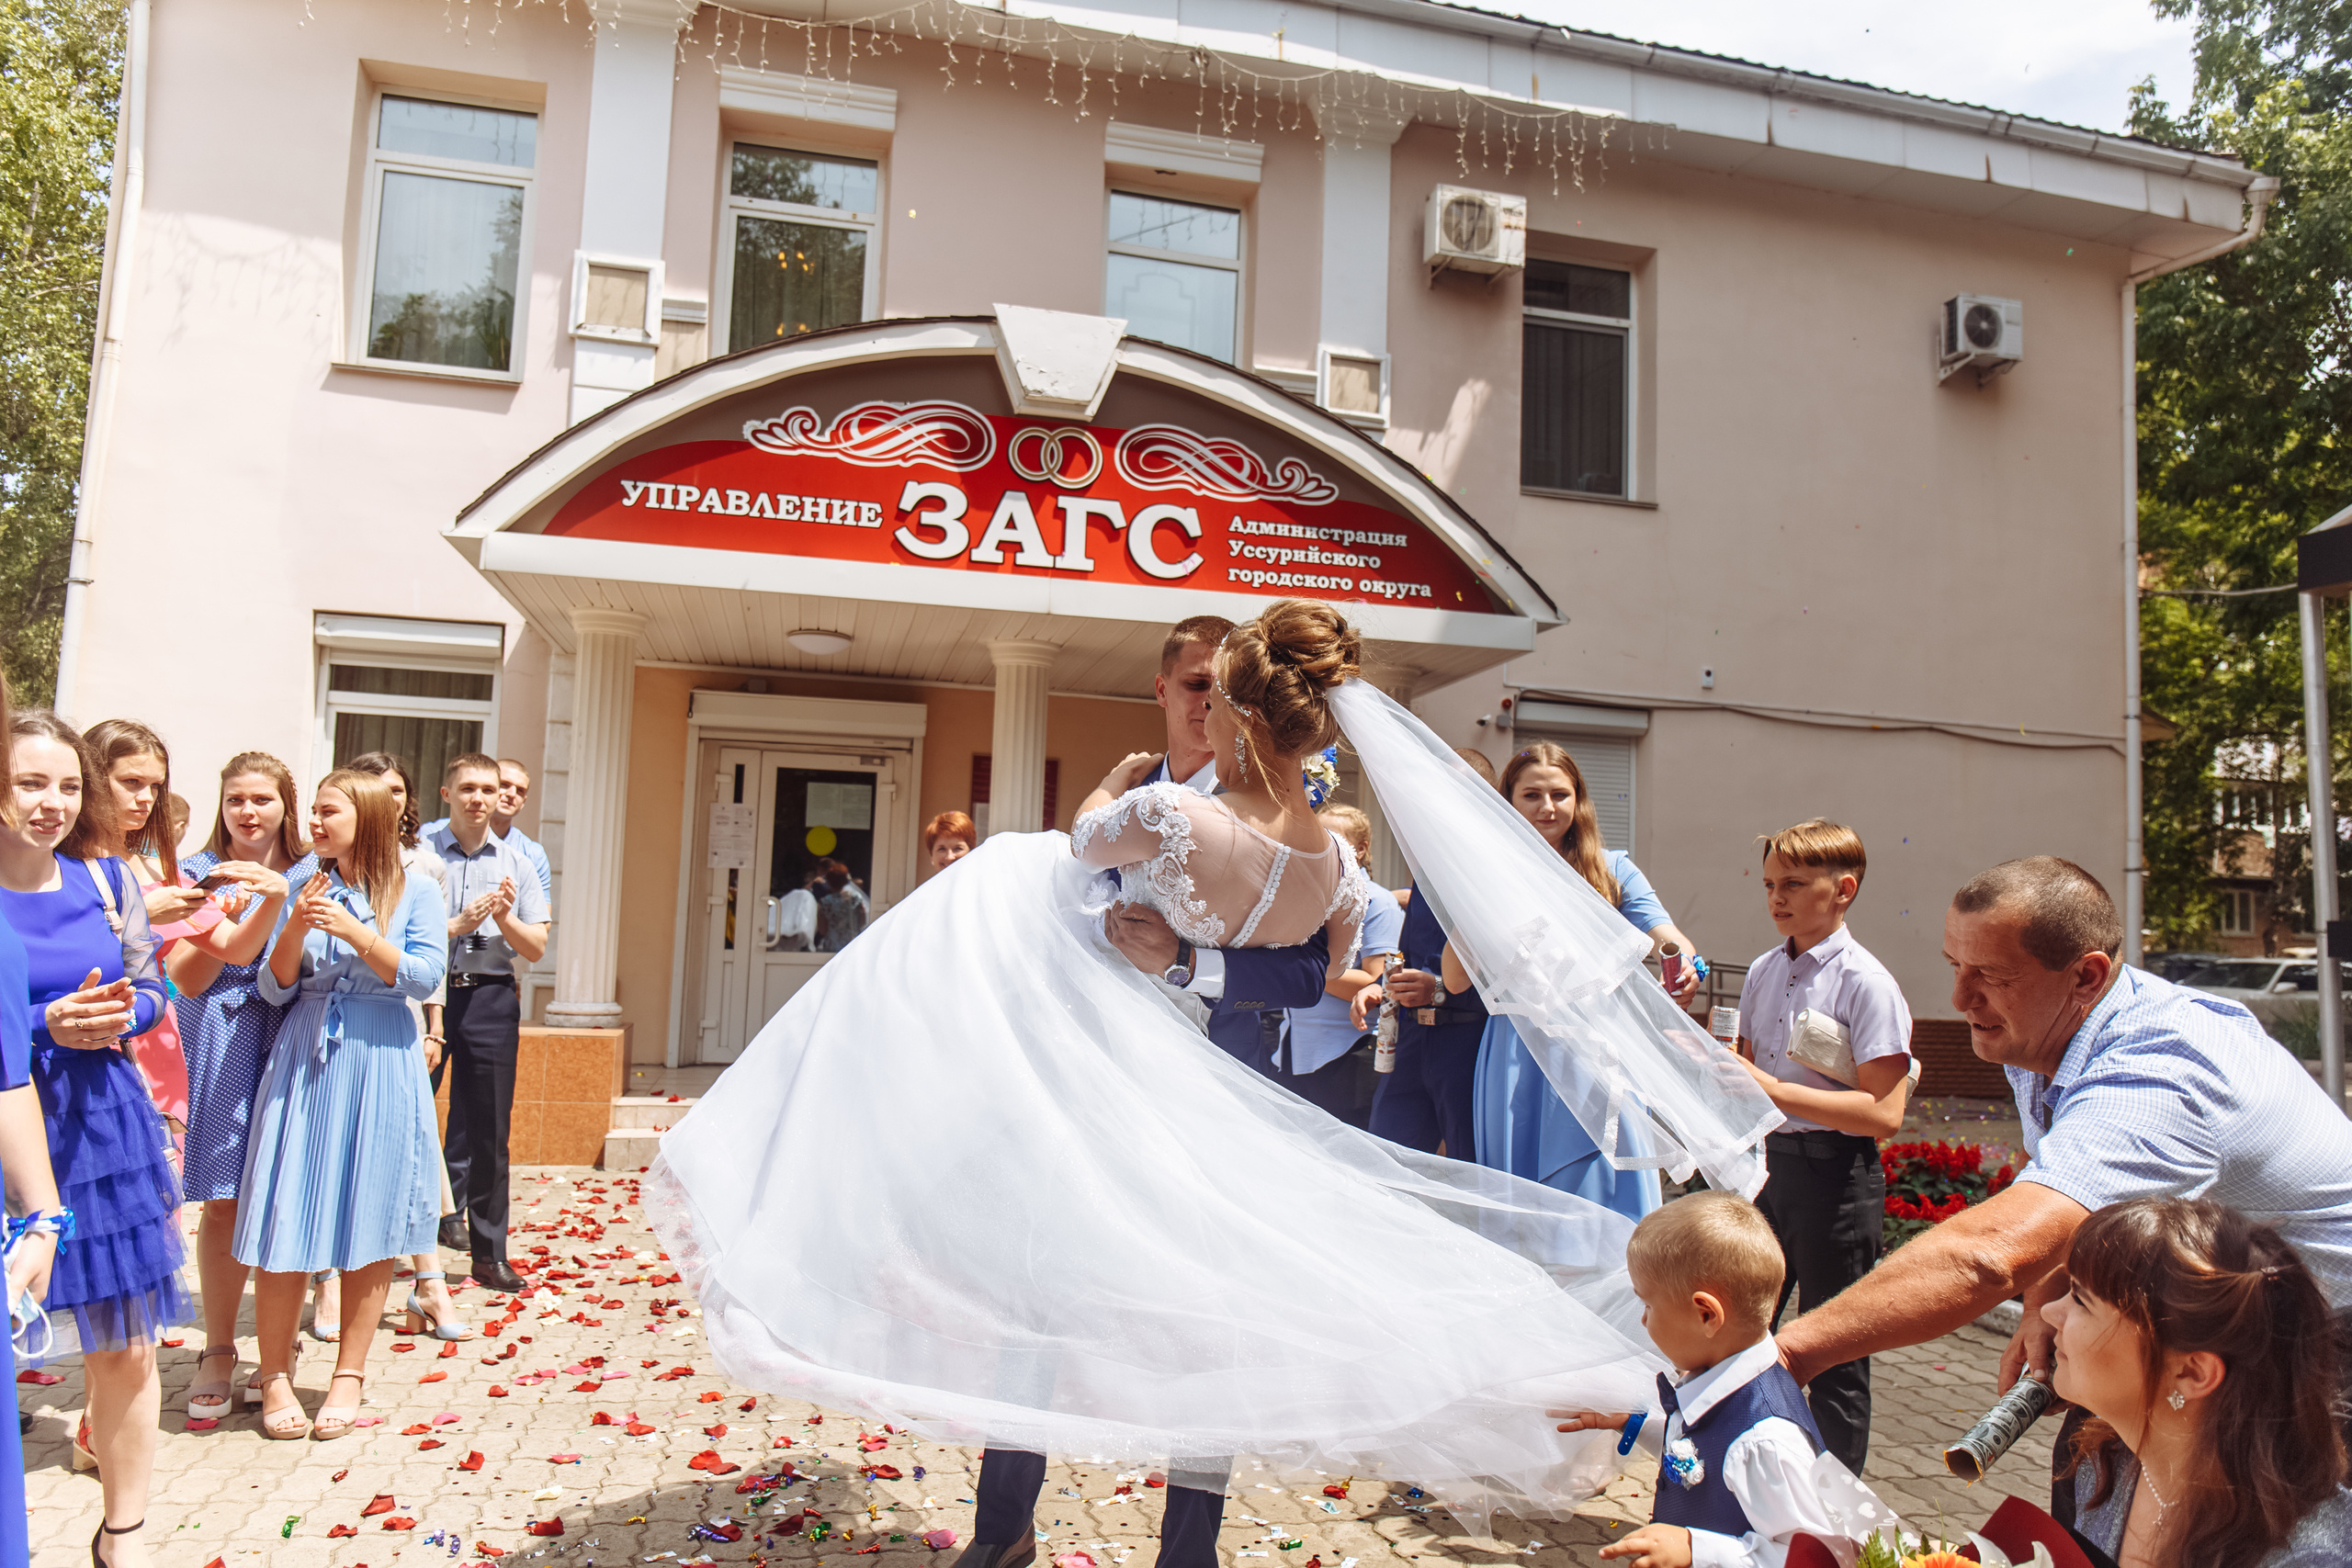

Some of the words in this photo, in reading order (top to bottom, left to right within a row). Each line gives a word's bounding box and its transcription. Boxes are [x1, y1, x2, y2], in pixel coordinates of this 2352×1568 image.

[620, 479, 883, 528] УПРАВЛЕНИЕ
[895, 480, 1204, 579] ЗАГС
[1228, 515, 1408, 547] Администрация
[1227, 539, 1381, 569] Уссурийского
[1227, 568, 1353, 591] городского
[1358, 579, 1432, 599] округа
